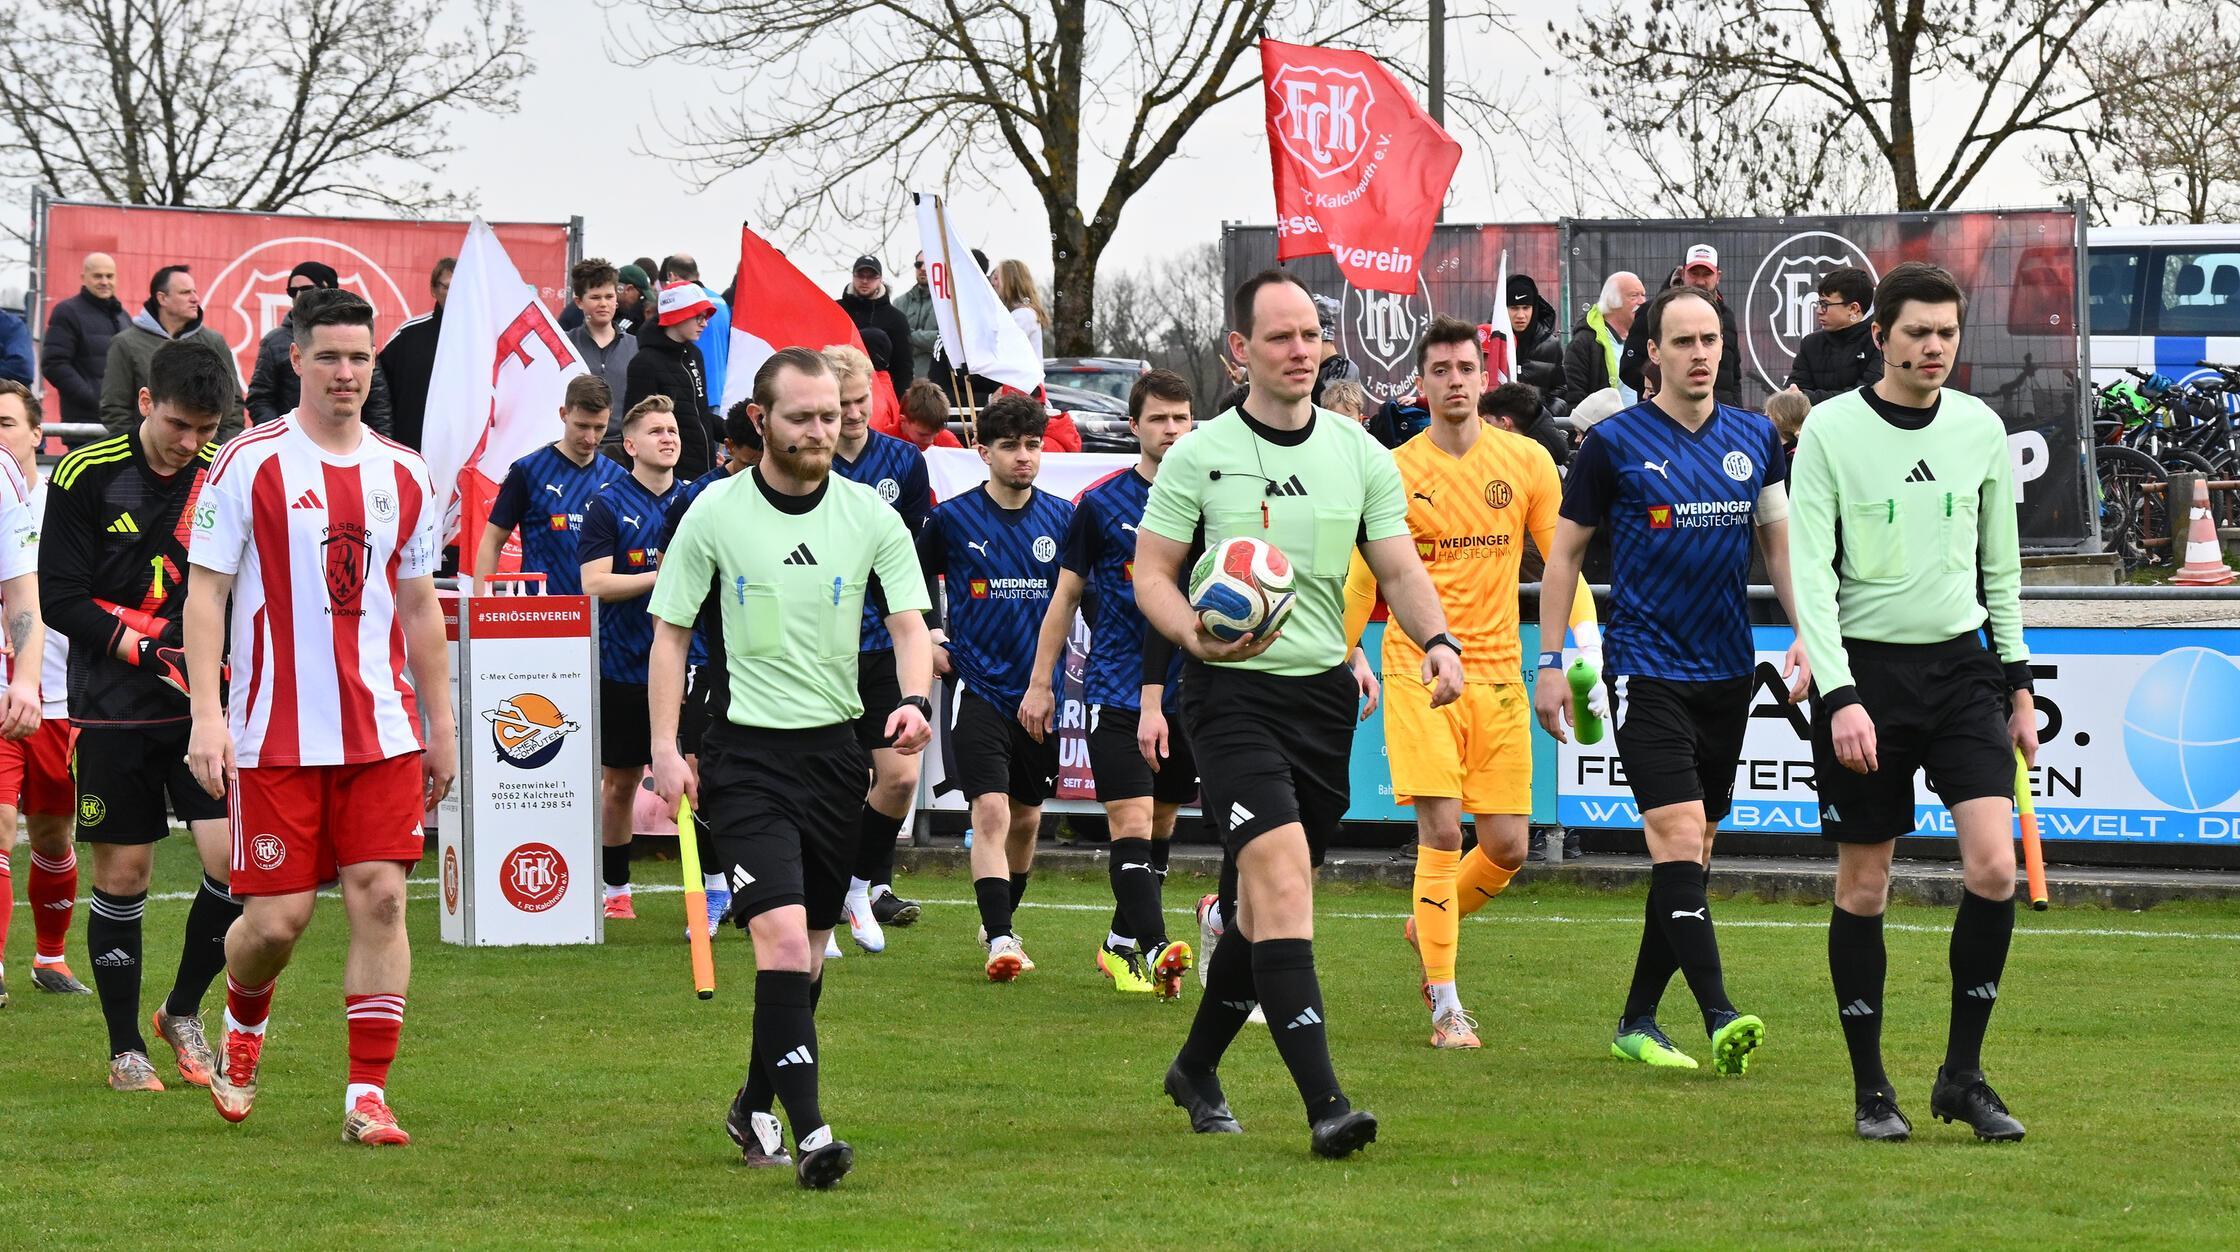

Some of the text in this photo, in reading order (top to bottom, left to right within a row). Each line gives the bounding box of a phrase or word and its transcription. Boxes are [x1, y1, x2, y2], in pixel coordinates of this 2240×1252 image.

[1315, 161, 1378, 209] Kalchreuth
[1675, 500, 1752, 515] WEIDINGER
[321, 522, 373, 540] PILSBAR
[1439, 535, 1510, 549] WEIDINGER
[151, 555, 164, 599] 1
[989, 578, 1048, 589] WEIDINGER
[478, 611, 582, 623] #SERIÖSERVEREIN
[480, 671, 582, 682] C-Mex Computer & mehr
[499, 781, 559, 790] Rosenwinkel
[1063, 777, 1082, 788] SEIT
[491, 791, 575, 800] 90562 Kalchreuth
[495, 802, 517, 810] 0151
[541, 801, 558, 809] 298
[561, 800, 572, 808] 54
[95, 956, 136, 968] adidas
